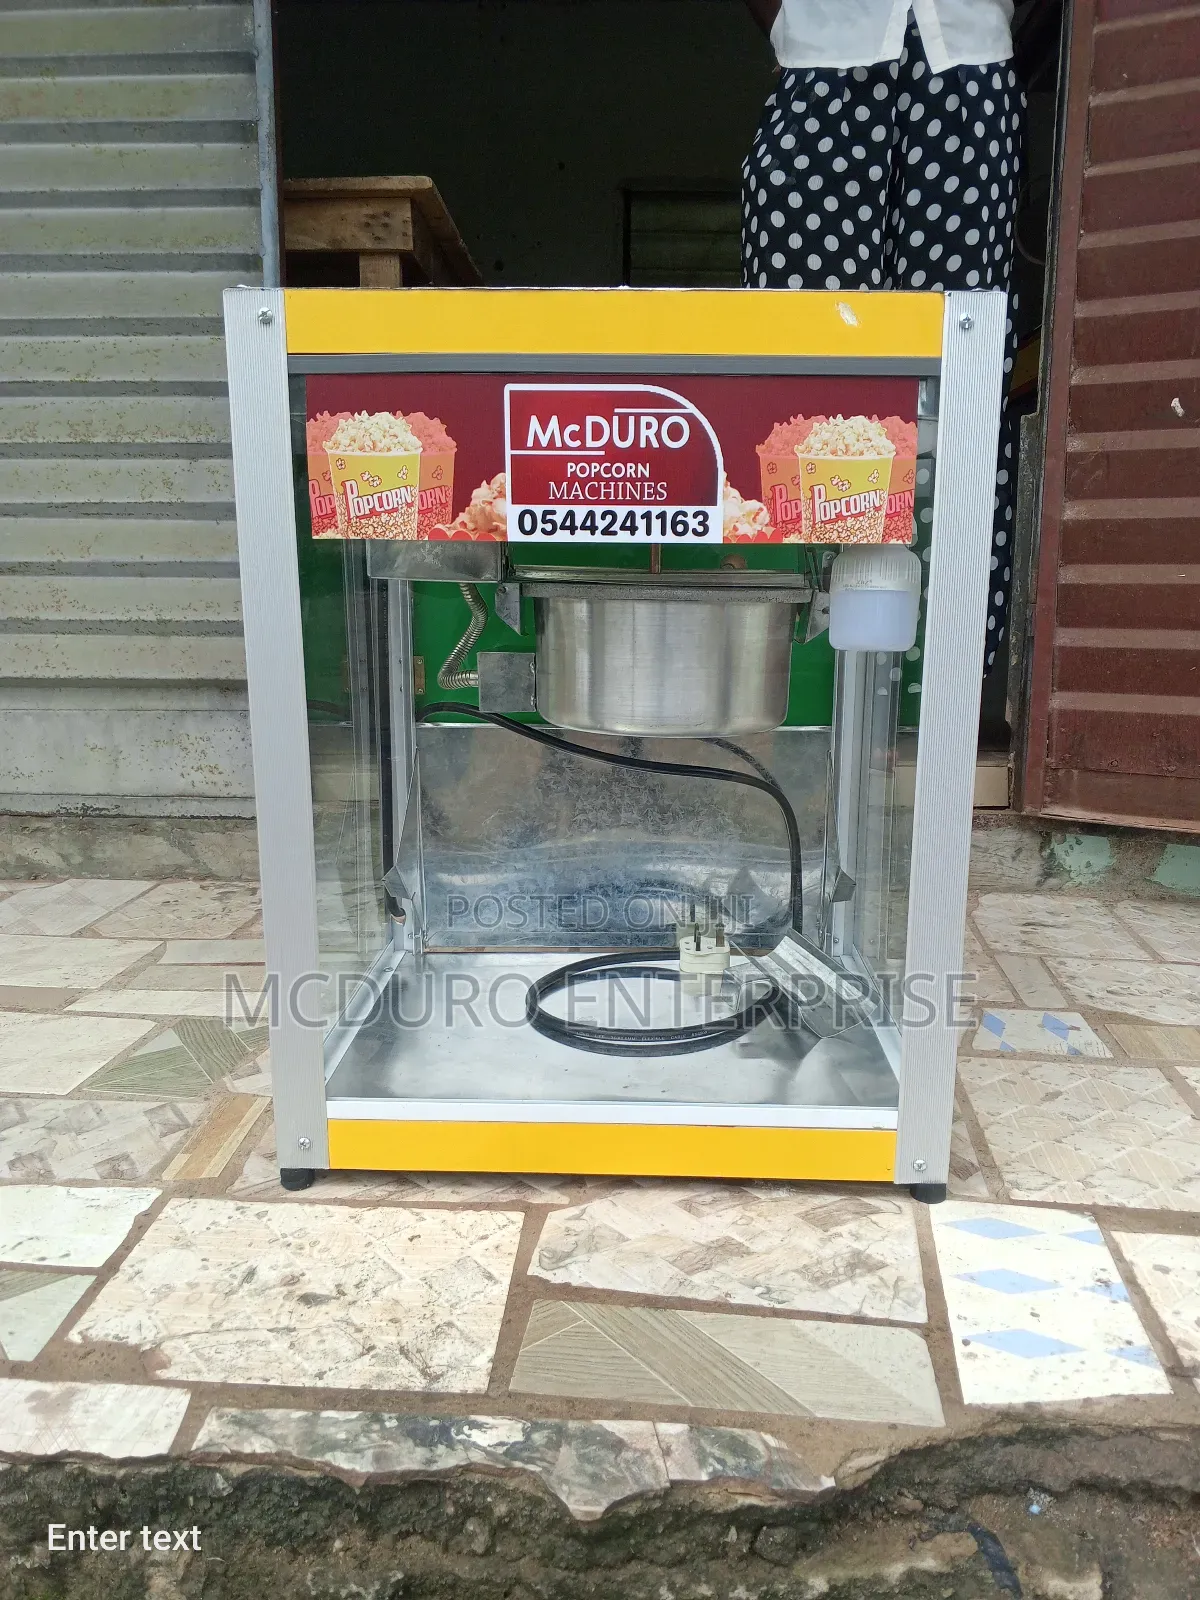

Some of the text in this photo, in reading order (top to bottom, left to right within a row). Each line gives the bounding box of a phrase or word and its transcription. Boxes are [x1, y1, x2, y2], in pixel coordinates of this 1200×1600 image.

[526, 415, 690, 448] McDURO
[567, 463, 650, 478] POPCORN
[343, 479, 413, 520] POPCORN
[548, 481, 668, 501] MACHINES
[811, 484, 881, 524] POPCORN
[517, 509, 710, 537] 0544241163
